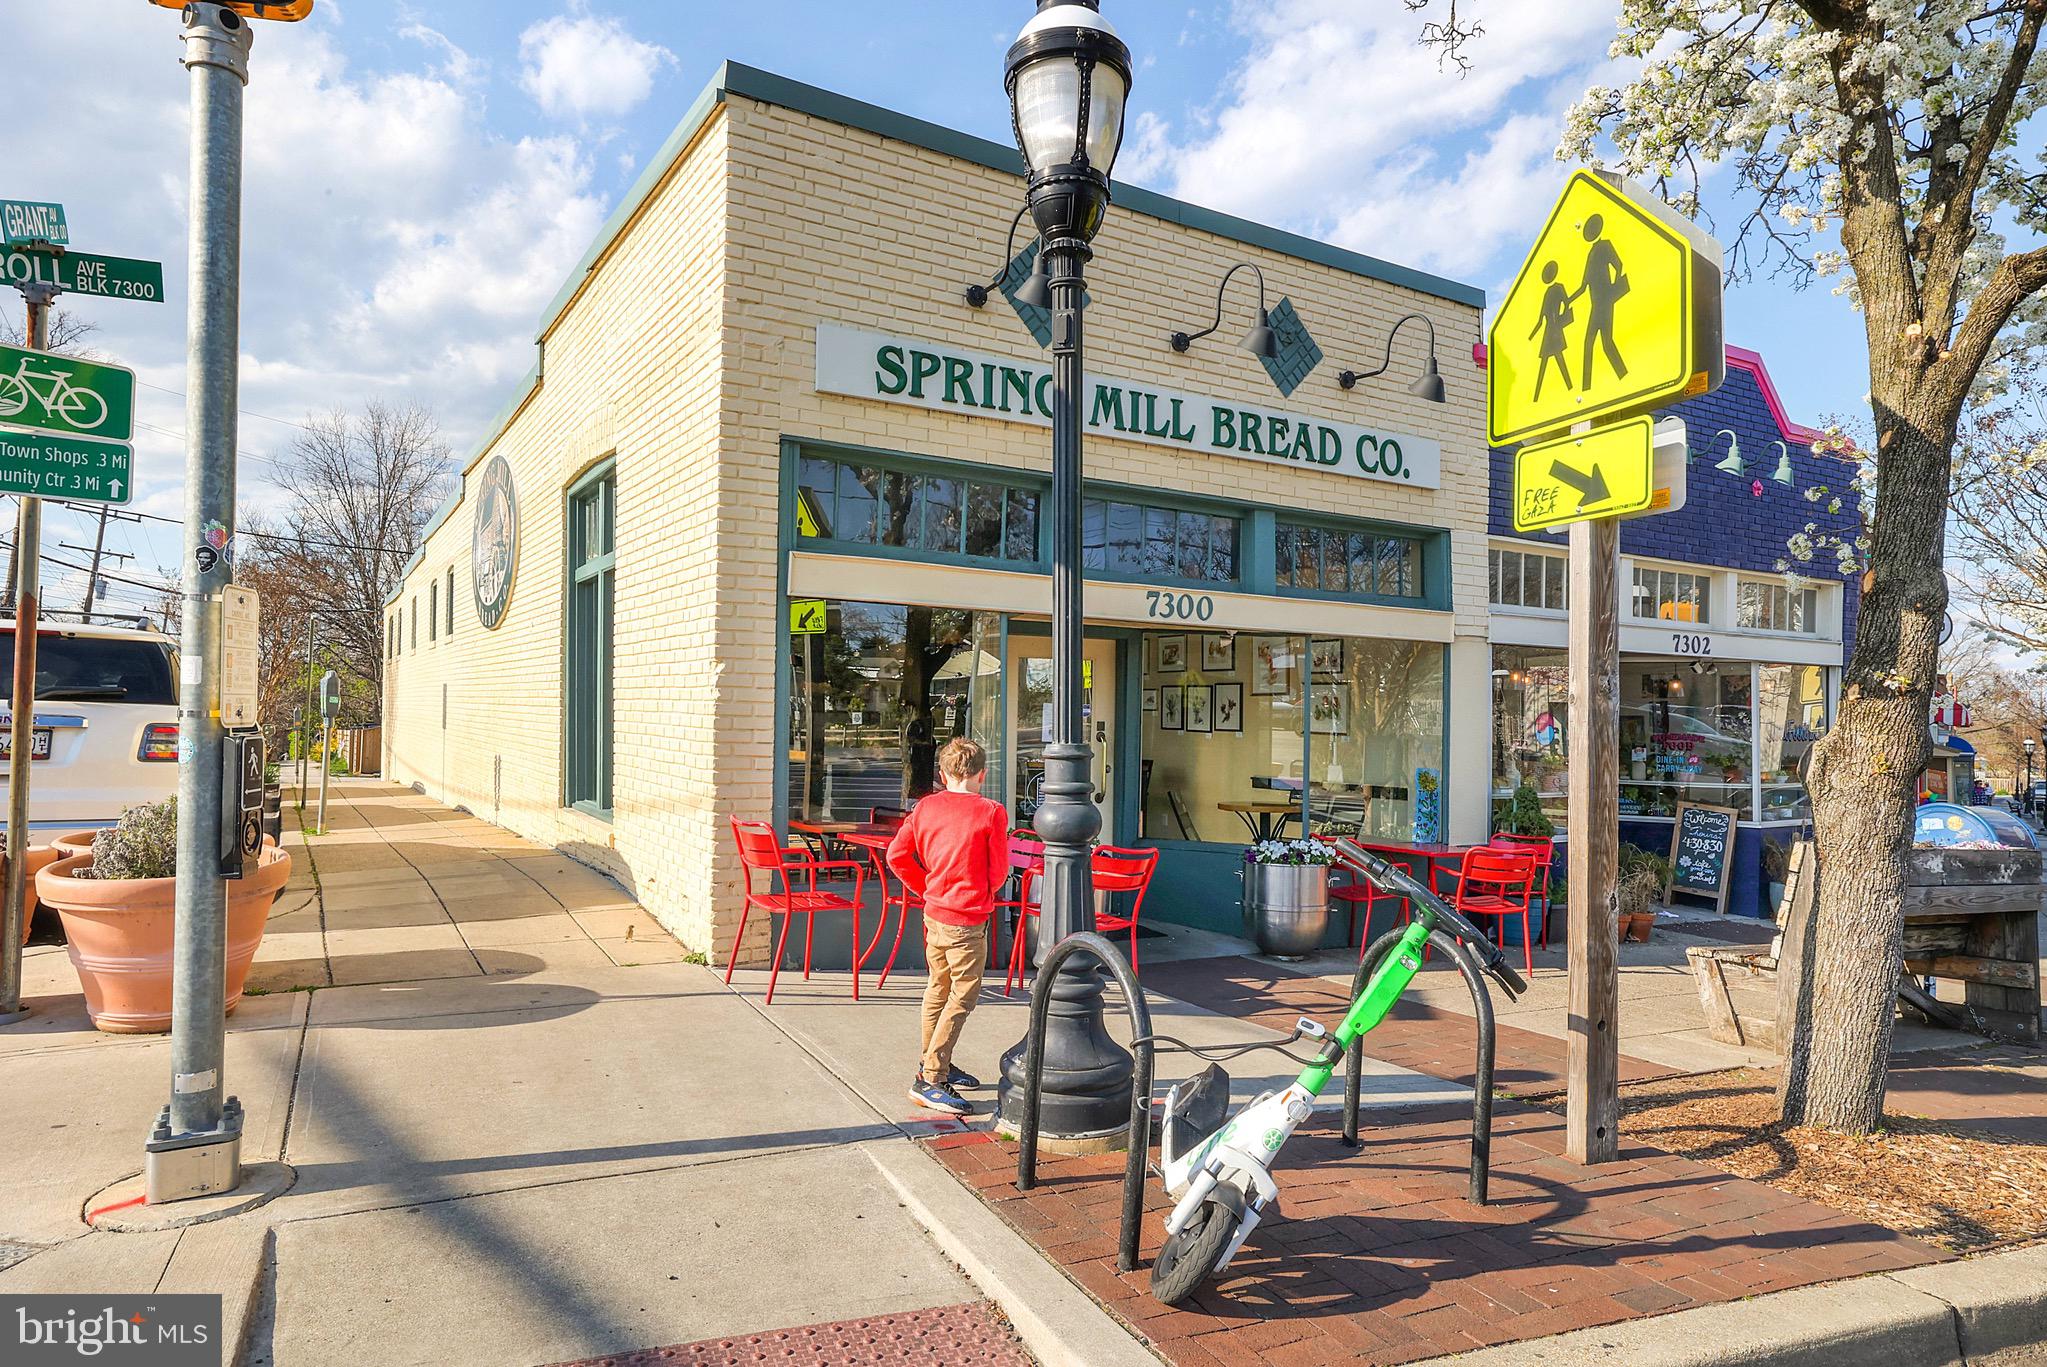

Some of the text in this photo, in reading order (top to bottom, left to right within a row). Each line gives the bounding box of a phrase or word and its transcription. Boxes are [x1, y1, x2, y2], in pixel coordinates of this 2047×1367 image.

[5, 203, 49, 237] GRANT
[50, 225, 59, 240] BLK
[76, 260, 106, 278] AVE
[76, 275, 155, 299] BLK 7300
[1088, 384, 1196, 443] MILL
[1211, 405, 1342, 466] BREAD
[1356, 434, 1411, 480] CO.
[0, 441, 127, 470] Town Shops .3 Mi
[0, 467, 100, 491] unity Ctr .3 Mi
[1523, 486, 1561, 507] FREE
[1521, 501, 1557, 521] GAZA
[1146, 591, 1214, 621] 7300
[1672, 634, 1711, 655] 7302
[1656, 755, 1685, 764] DINE-IN
